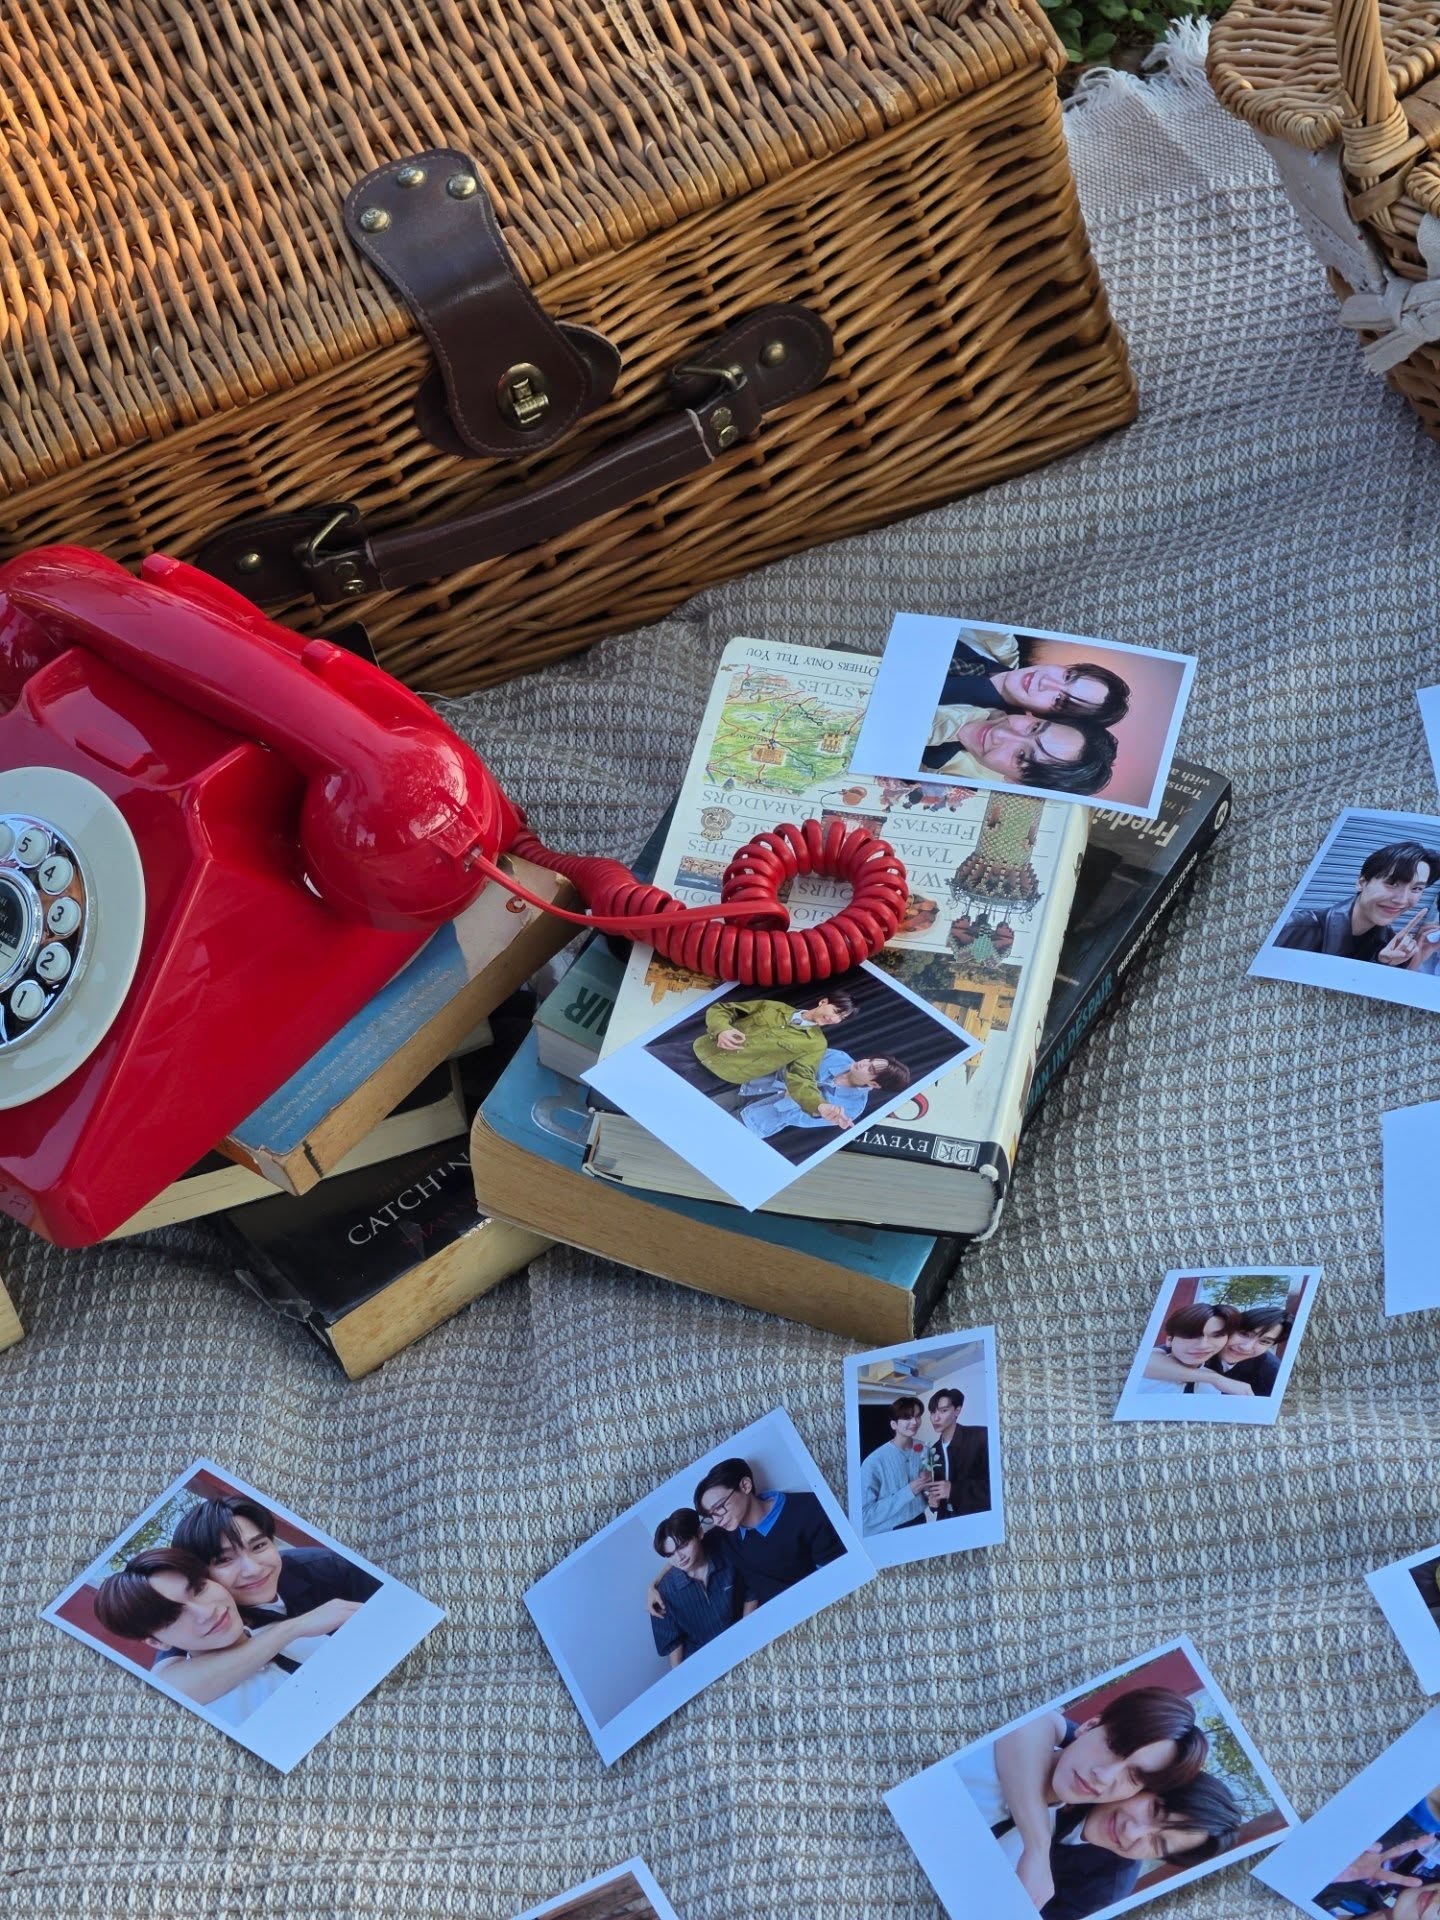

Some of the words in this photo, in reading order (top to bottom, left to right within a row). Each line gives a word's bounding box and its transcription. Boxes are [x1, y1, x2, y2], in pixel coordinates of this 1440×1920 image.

[746, 647, 770, 661] YOU
[776, 652, 800, 666] TELL
[803, 655, 833, 670] ONLY
[837, 661, 880, 678] OTHERS
[1181, 771, 1210, 786] with
[1166, 780, 1202, 800] Trans
[703, 790, 816, 821] PARADORS
[893, 818, 978, 841] FIESTAS
[18, 836, 32, 853] 5
[896, 844, 953, 864] TAPA
[44, 865, 57, 882] 4
[911, 869, 942, 888] WI
[51, 906, 65, 923] 3
[39, 951, 55, 971] 2
[16, 990, 28, 1008] 1
[1052, 1042, 1065, 1074] IN
[1068, 972, 1112, 1049] DESPAIR
[854, 1131, 930, 1153] EYEWI
[938, 1141, 973, 1163] DK
